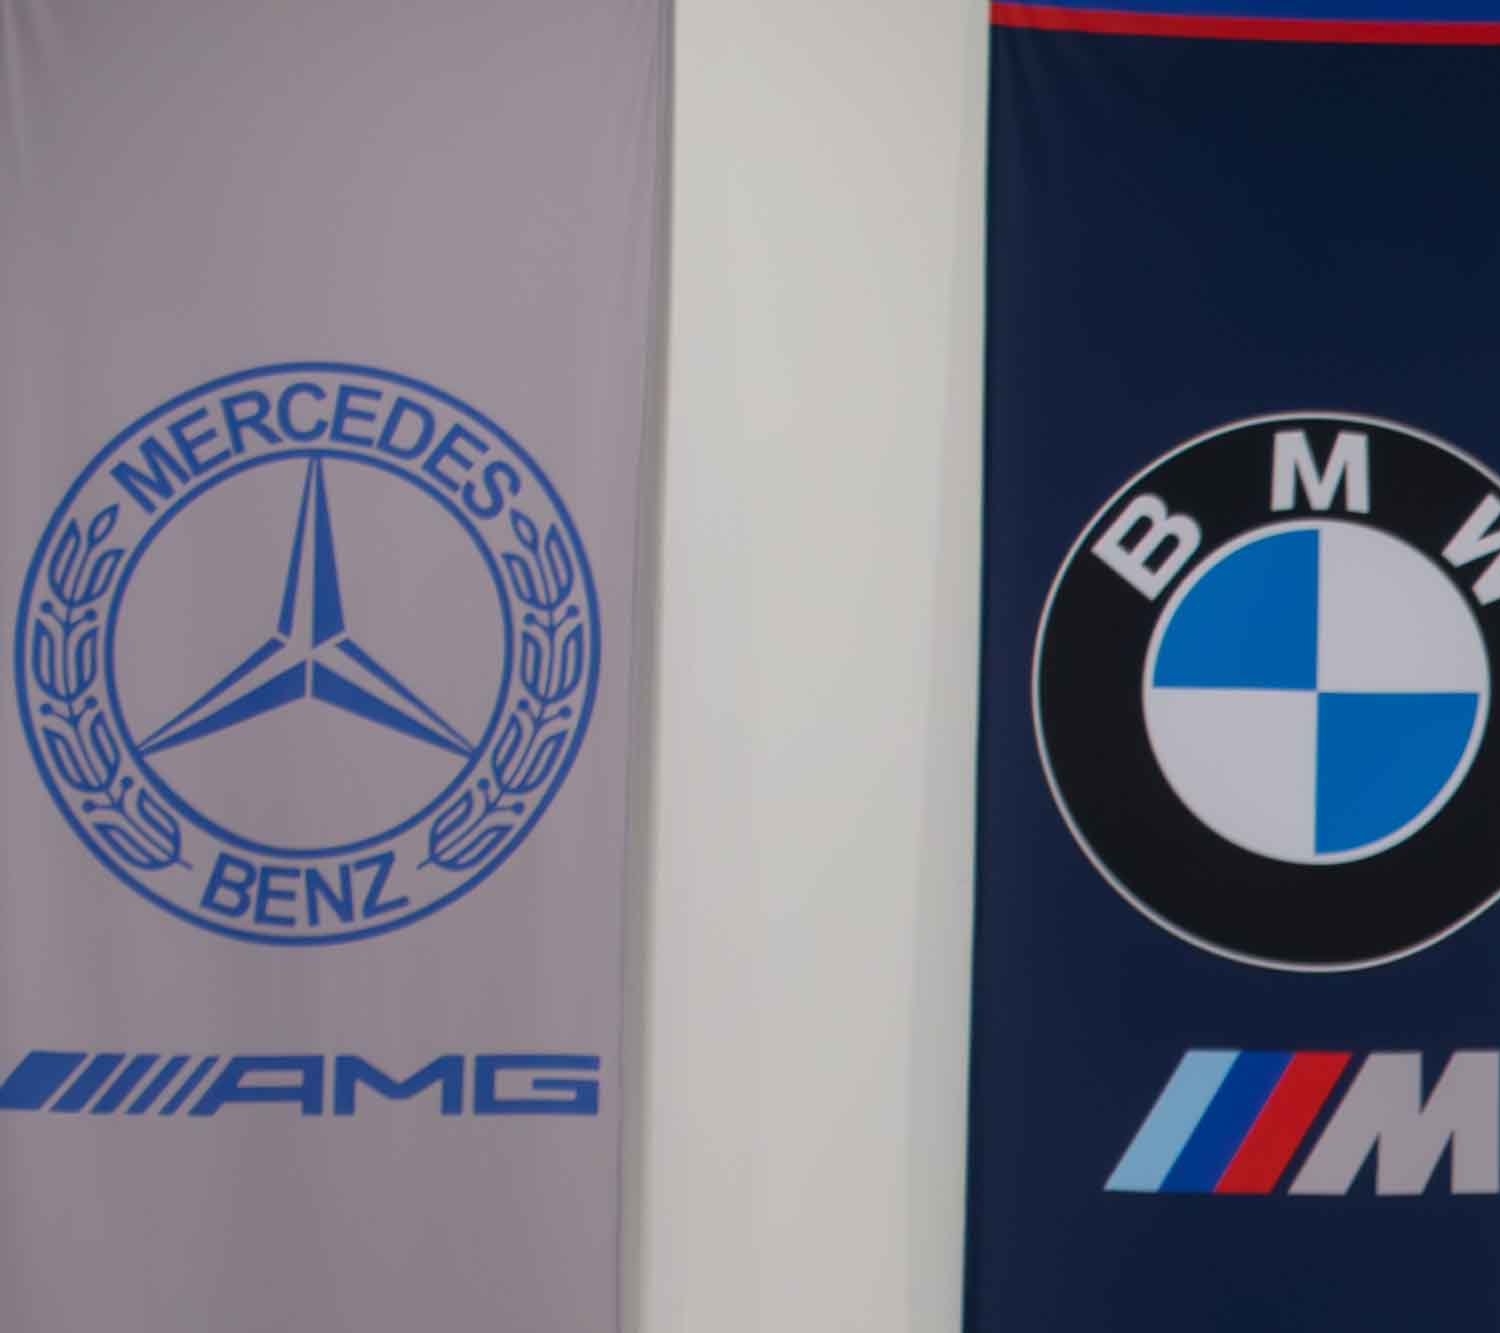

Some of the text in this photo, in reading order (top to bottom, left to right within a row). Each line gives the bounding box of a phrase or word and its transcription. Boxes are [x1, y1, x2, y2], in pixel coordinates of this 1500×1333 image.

[110, 381, 522, 521] MERCEDES
[200, 851, 409, 927] BENZ
[188, 1053, 600, 1117] AMG
